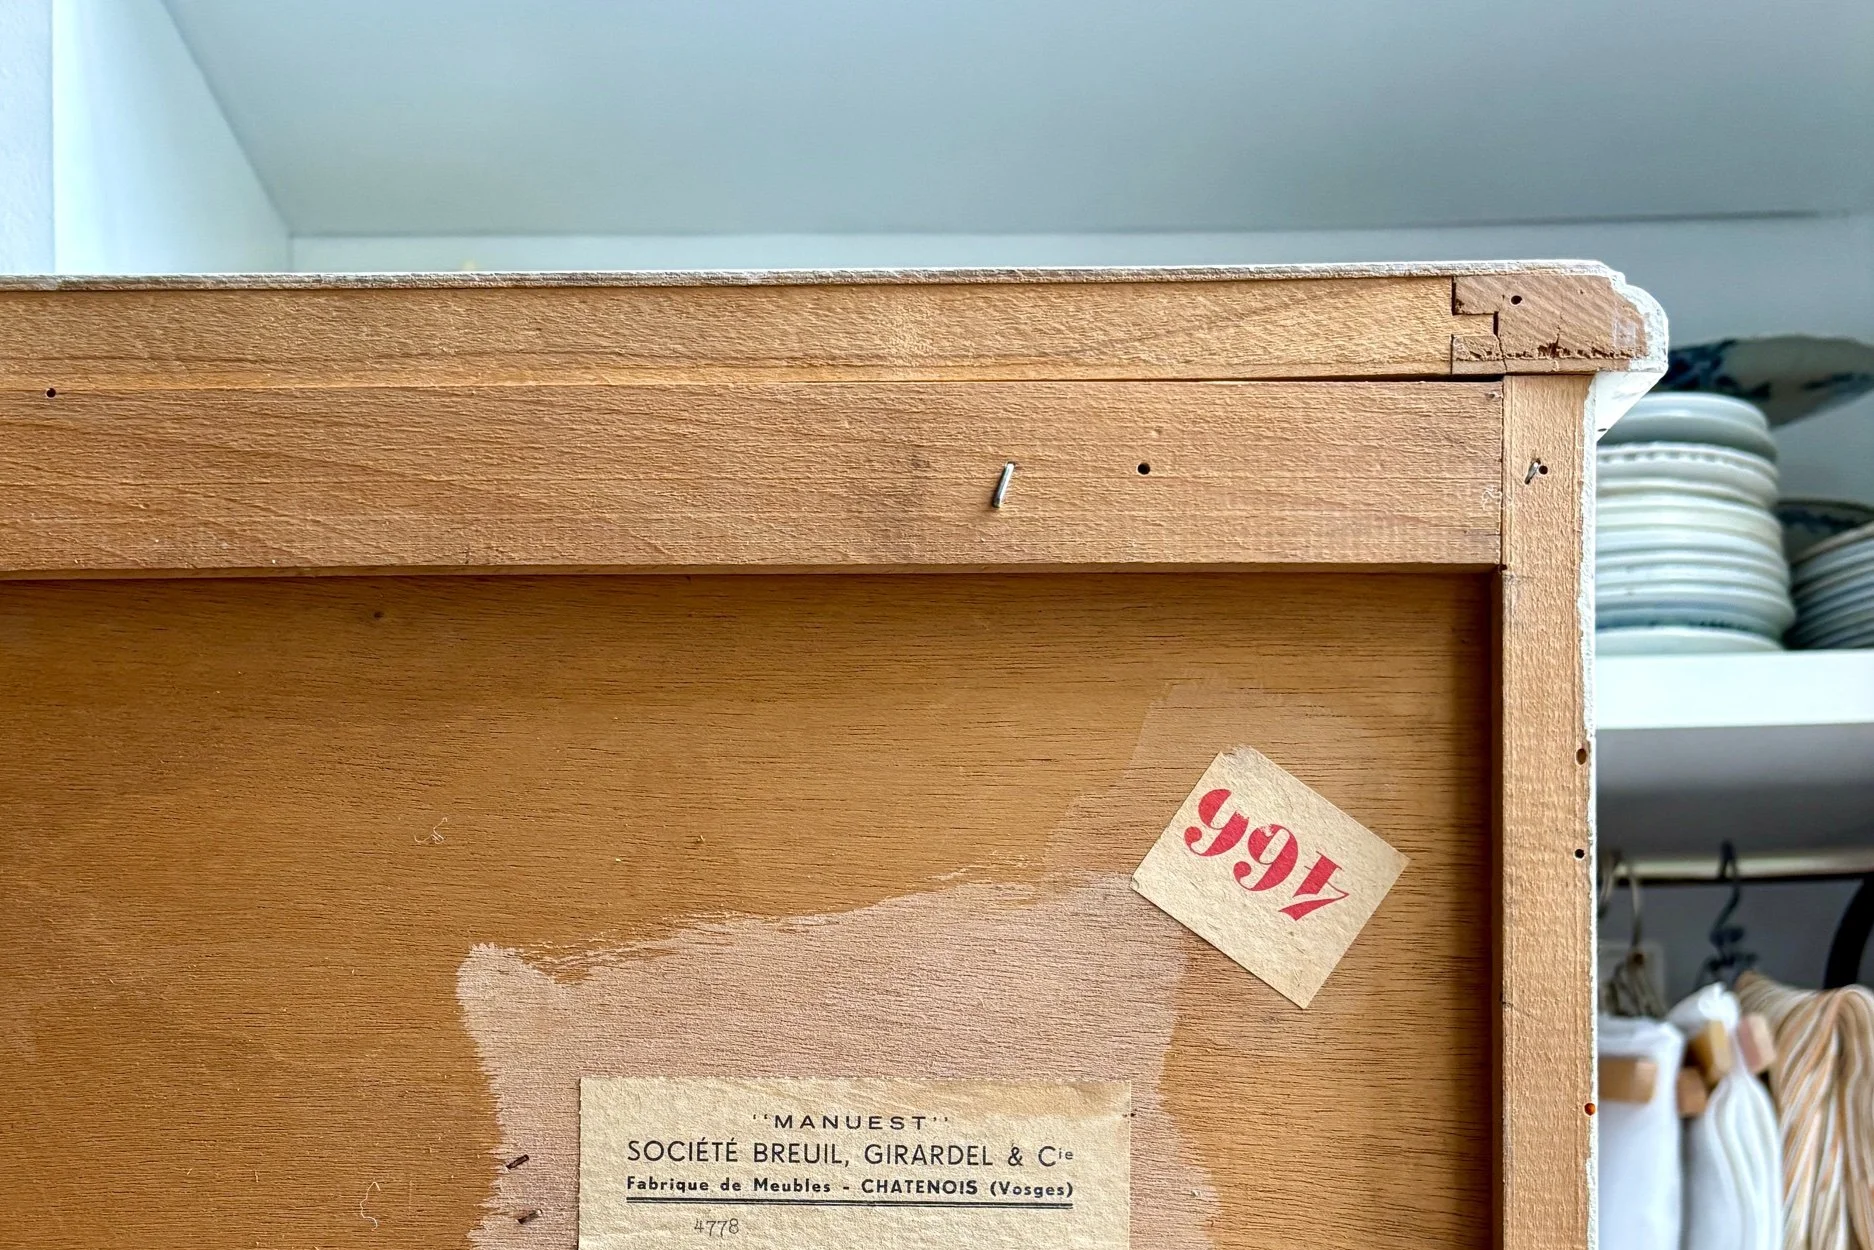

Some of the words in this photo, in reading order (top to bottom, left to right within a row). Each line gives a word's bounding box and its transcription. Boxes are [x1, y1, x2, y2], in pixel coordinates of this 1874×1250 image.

[1184, 788, 1350, 922] 466
[627, 1136, 738, 1162] SOCIÉTÉ
[753, 1142, 850, 1167] BREUIL,
[864, 1143, 993, 1166] GIRARDEL
[1007, 1146, 1023, 1167] &
[1038, 1145, 1074, 1167] Cie
[627, 1176, 709, 1194] Fabrique
[720, 1177, 742, 1192] de
[753, 1177, 831, 1193] Meubles
[861, 1178, 978, 1195] CHATENOIS
[989, 1180, 1074, 1198] (Vosges)
[694, 1217, 740, 1238] 4778
